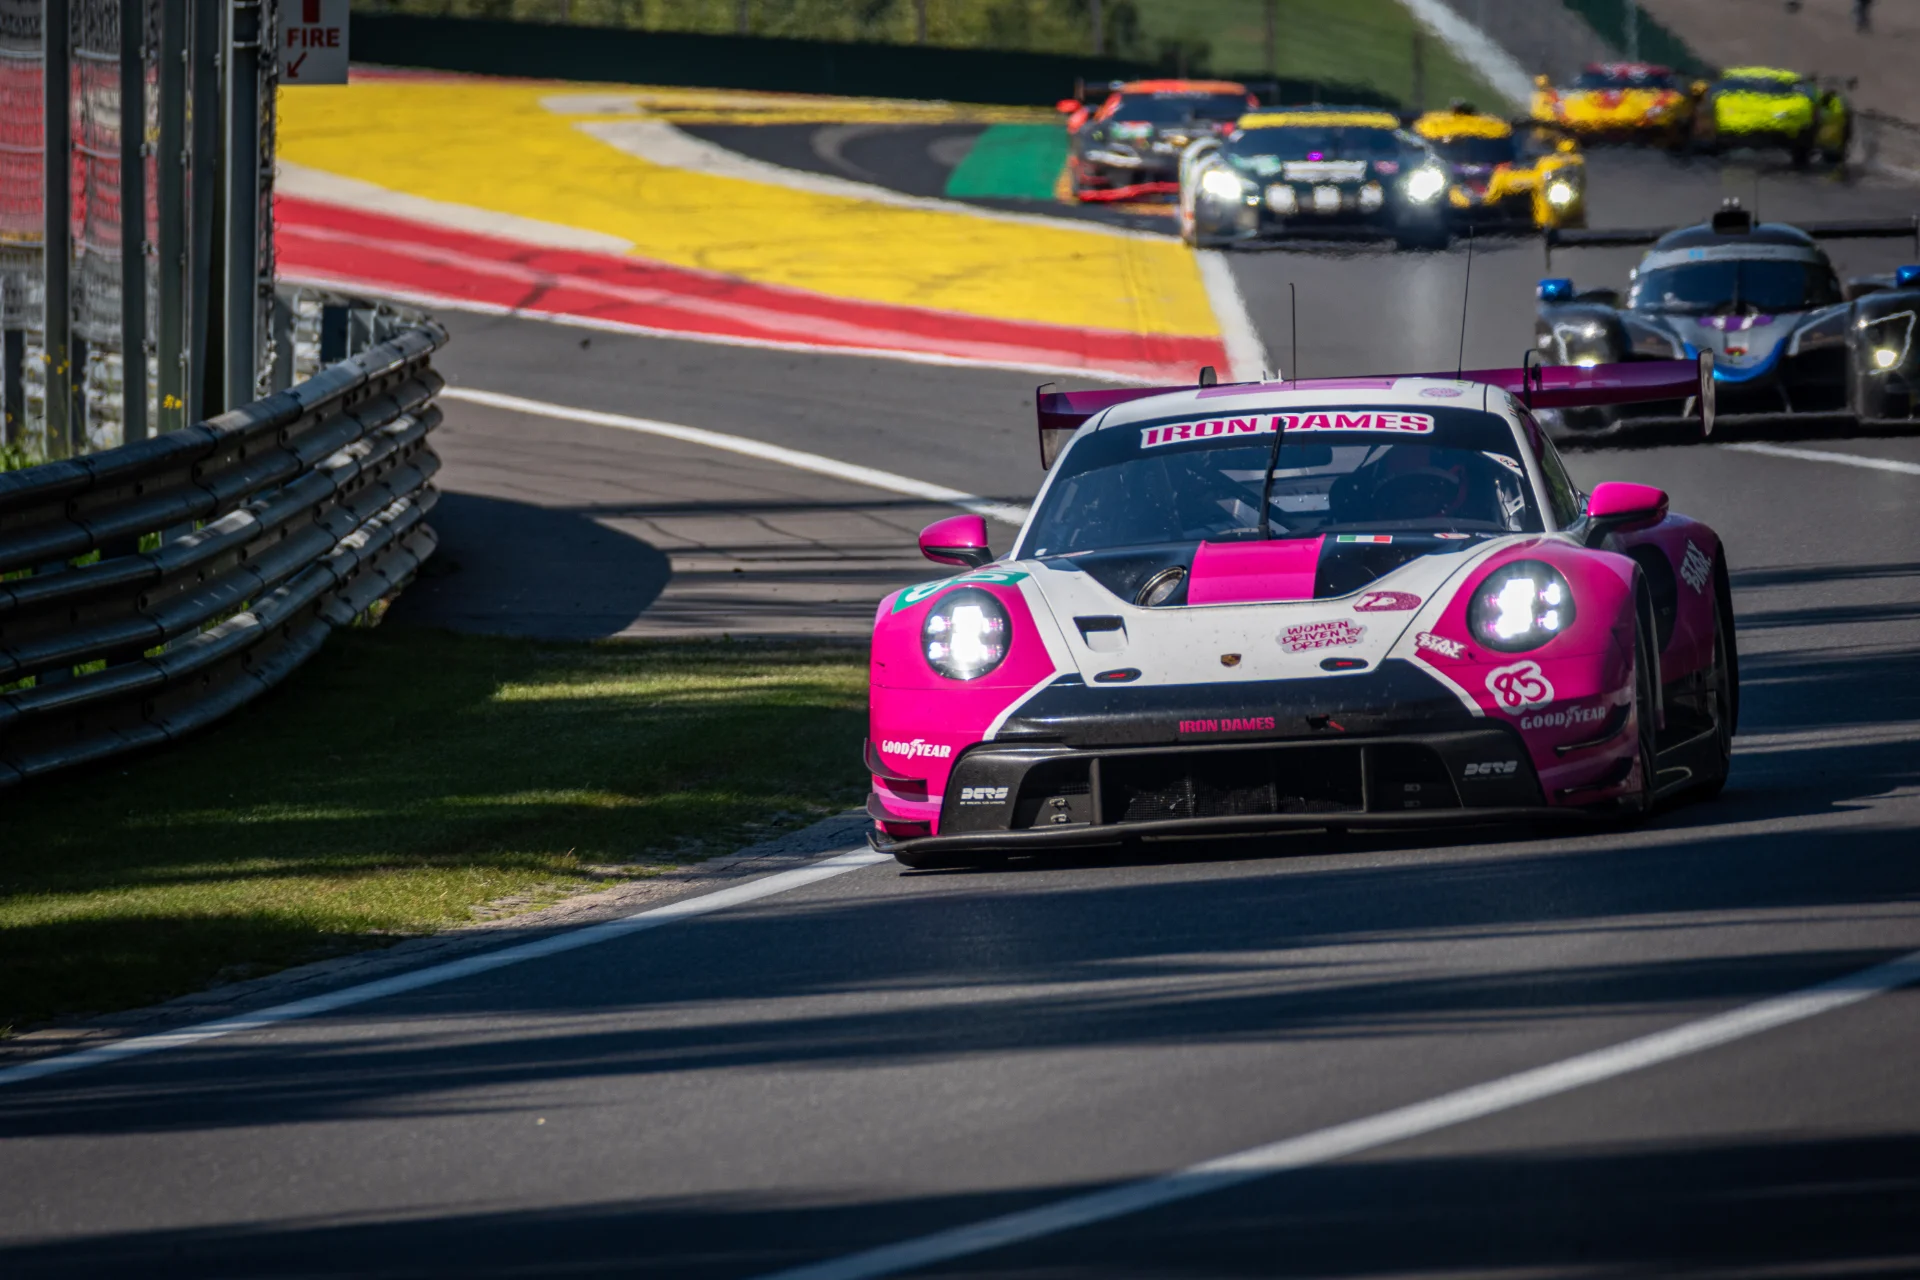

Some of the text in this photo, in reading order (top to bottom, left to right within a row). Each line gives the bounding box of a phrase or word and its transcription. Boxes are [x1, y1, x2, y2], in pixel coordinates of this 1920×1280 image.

[287, 27, 340, 48] FIRE
[1146, 413, 1429, 446] IRON DAMES
[1282, 626, 1363, 645] DRIVEN BY
[1287, 620, 1349, 636] WOMEN
[1291, 635, 1358, 652] DREAMS
[1494, 666, 1547, 707] 85
[1179, 716, 1275, 733] IRON DAMES
[1520, 705, 1606, 730] GOODYEAR
[882, 738, 951, 759] GOODYEAR
